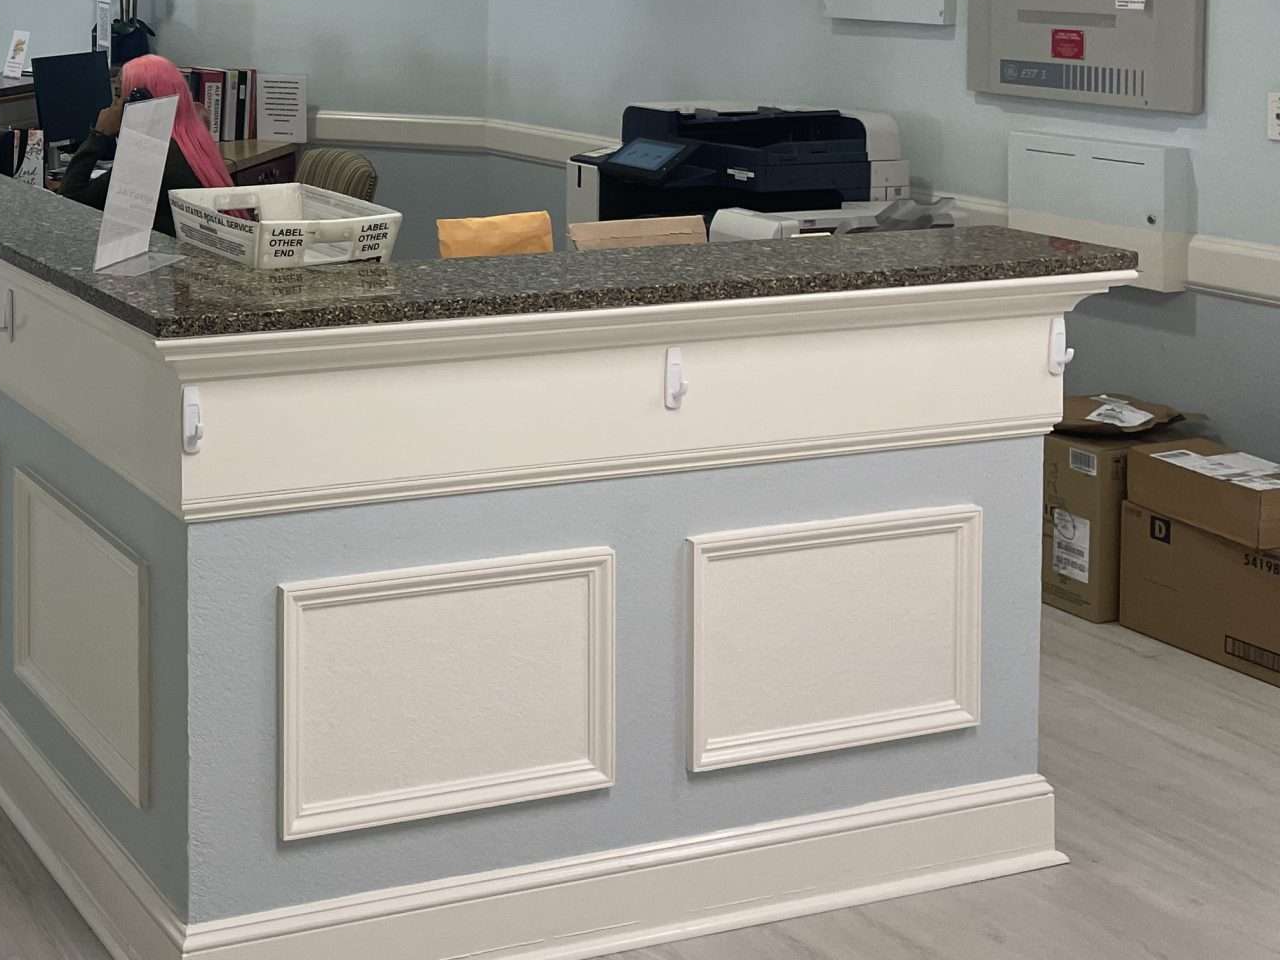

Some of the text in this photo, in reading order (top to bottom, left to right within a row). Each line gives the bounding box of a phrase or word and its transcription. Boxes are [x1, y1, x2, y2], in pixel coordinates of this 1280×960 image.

[185, 205, 203, 219] STATES
[204, 212, 226, 227] POSTAL
[226, 219, 254, 234] SERVICE
[271, 228, 304, 237] LABEL
[361, 222, 389, 233] LABEL
[358, 232, 388, 243] OTHER
[269, 239, 303, 248] OTHER
[361, 243, 380, 252] END
[273, 249, 295, 258] END
[1154, 519, 1166, 538] D
